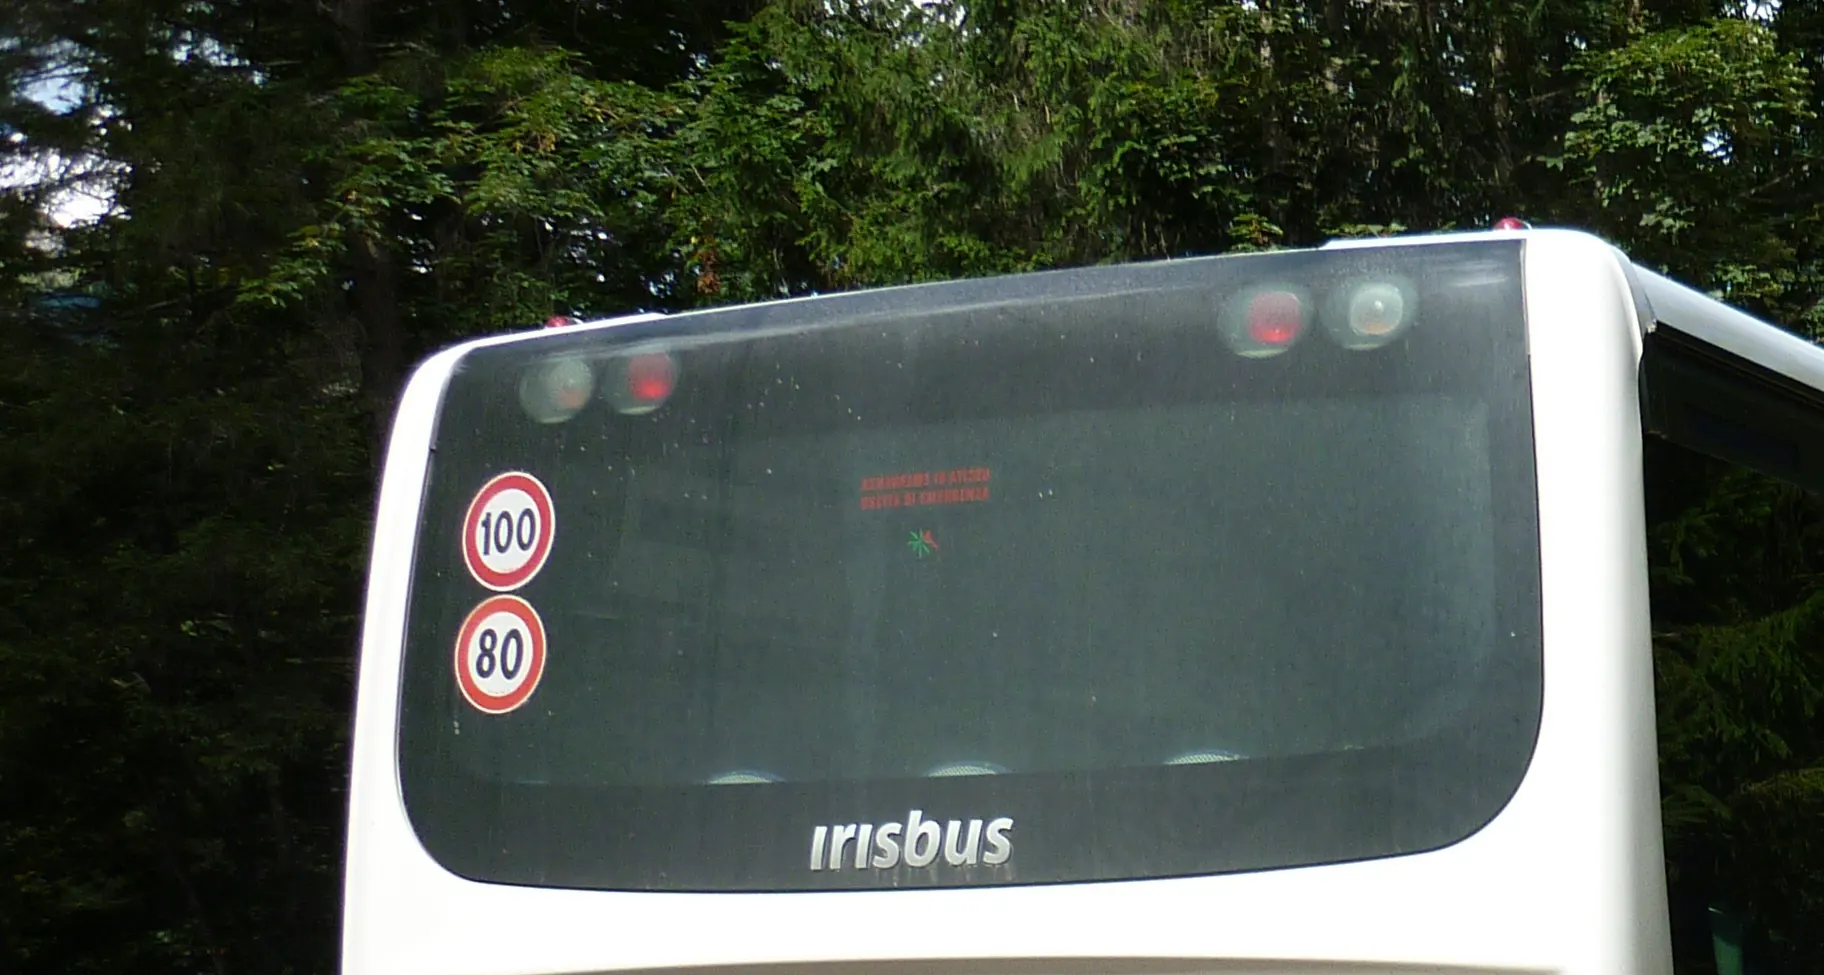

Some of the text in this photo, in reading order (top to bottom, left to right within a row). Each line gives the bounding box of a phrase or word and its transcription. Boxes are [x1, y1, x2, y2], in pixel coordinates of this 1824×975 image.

[481, 508, 536, 556] 100
[476, 628, 524, 680] 80
[810, 809, 1014, 871] irisbus
